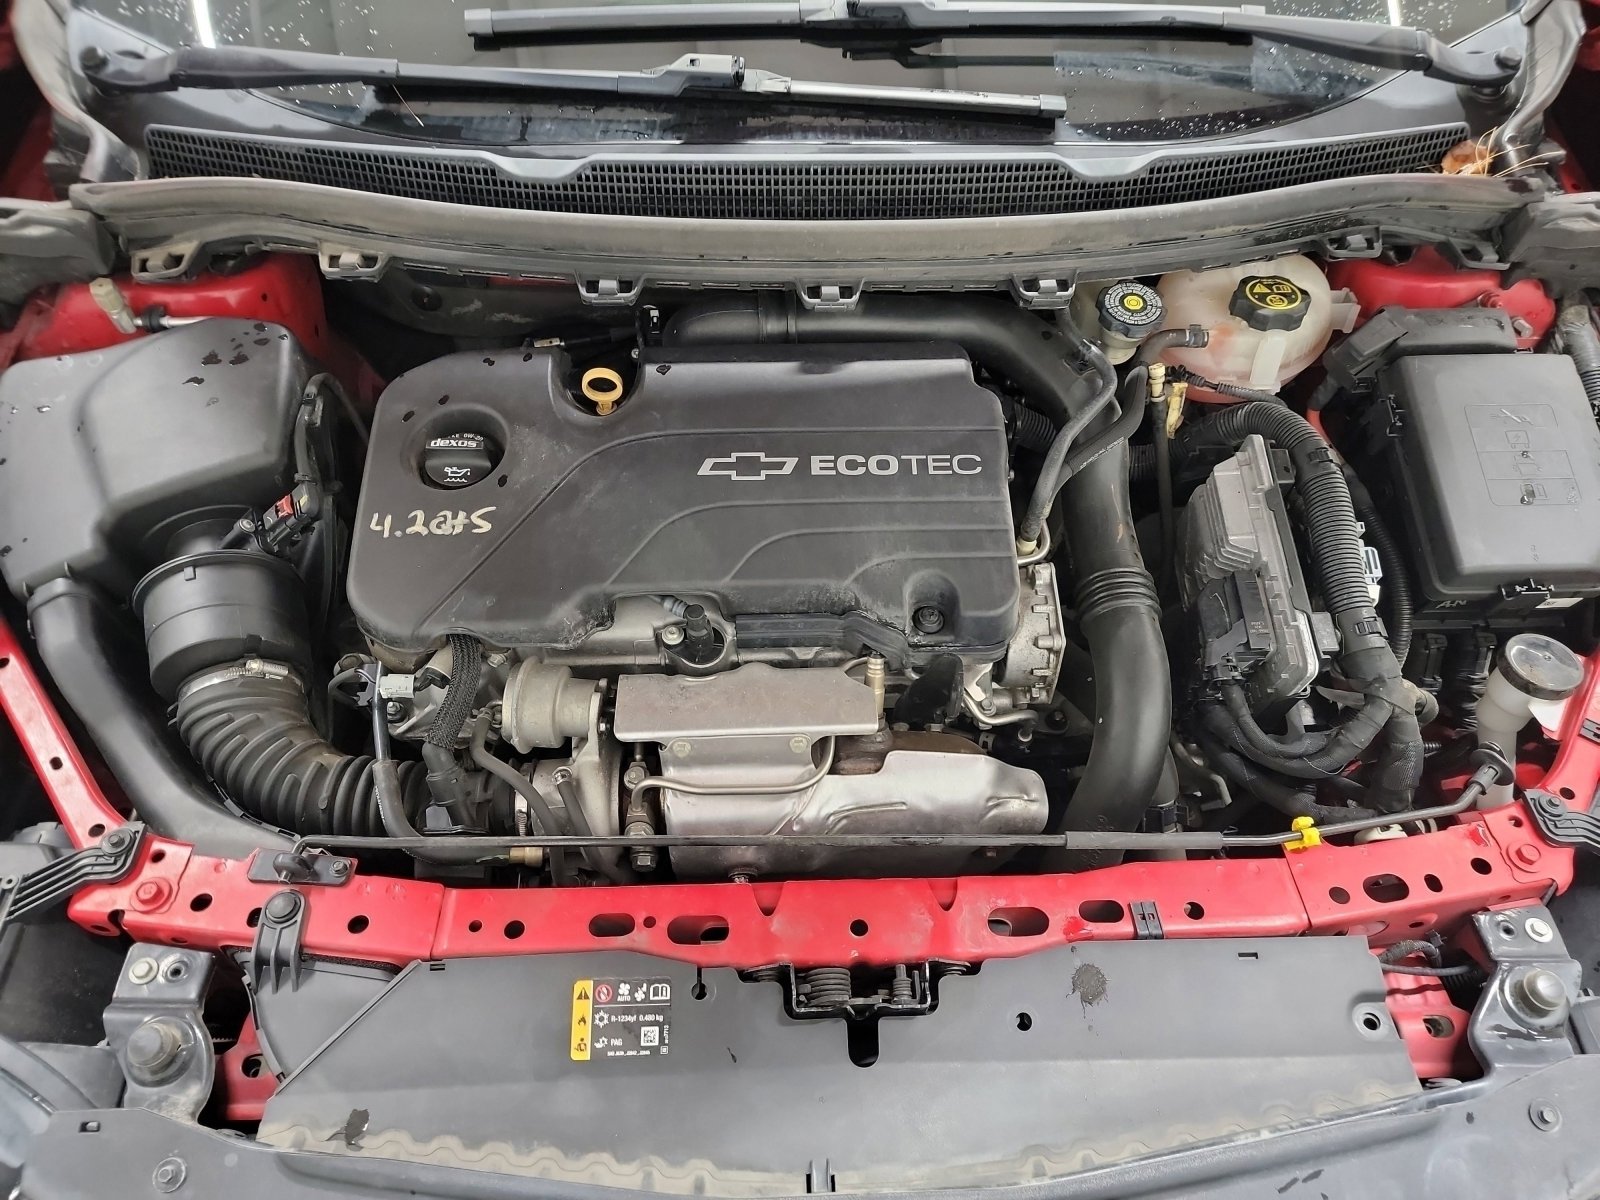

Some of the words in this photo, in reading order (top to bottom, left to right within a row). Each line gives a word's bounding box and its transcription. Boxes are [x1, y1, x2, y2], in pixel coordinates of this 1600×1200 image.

[430, 438, 477, 448] dexos
[811, 454, 983, 475] ECOTEC
[656, 1013, 664, 1022] kg
